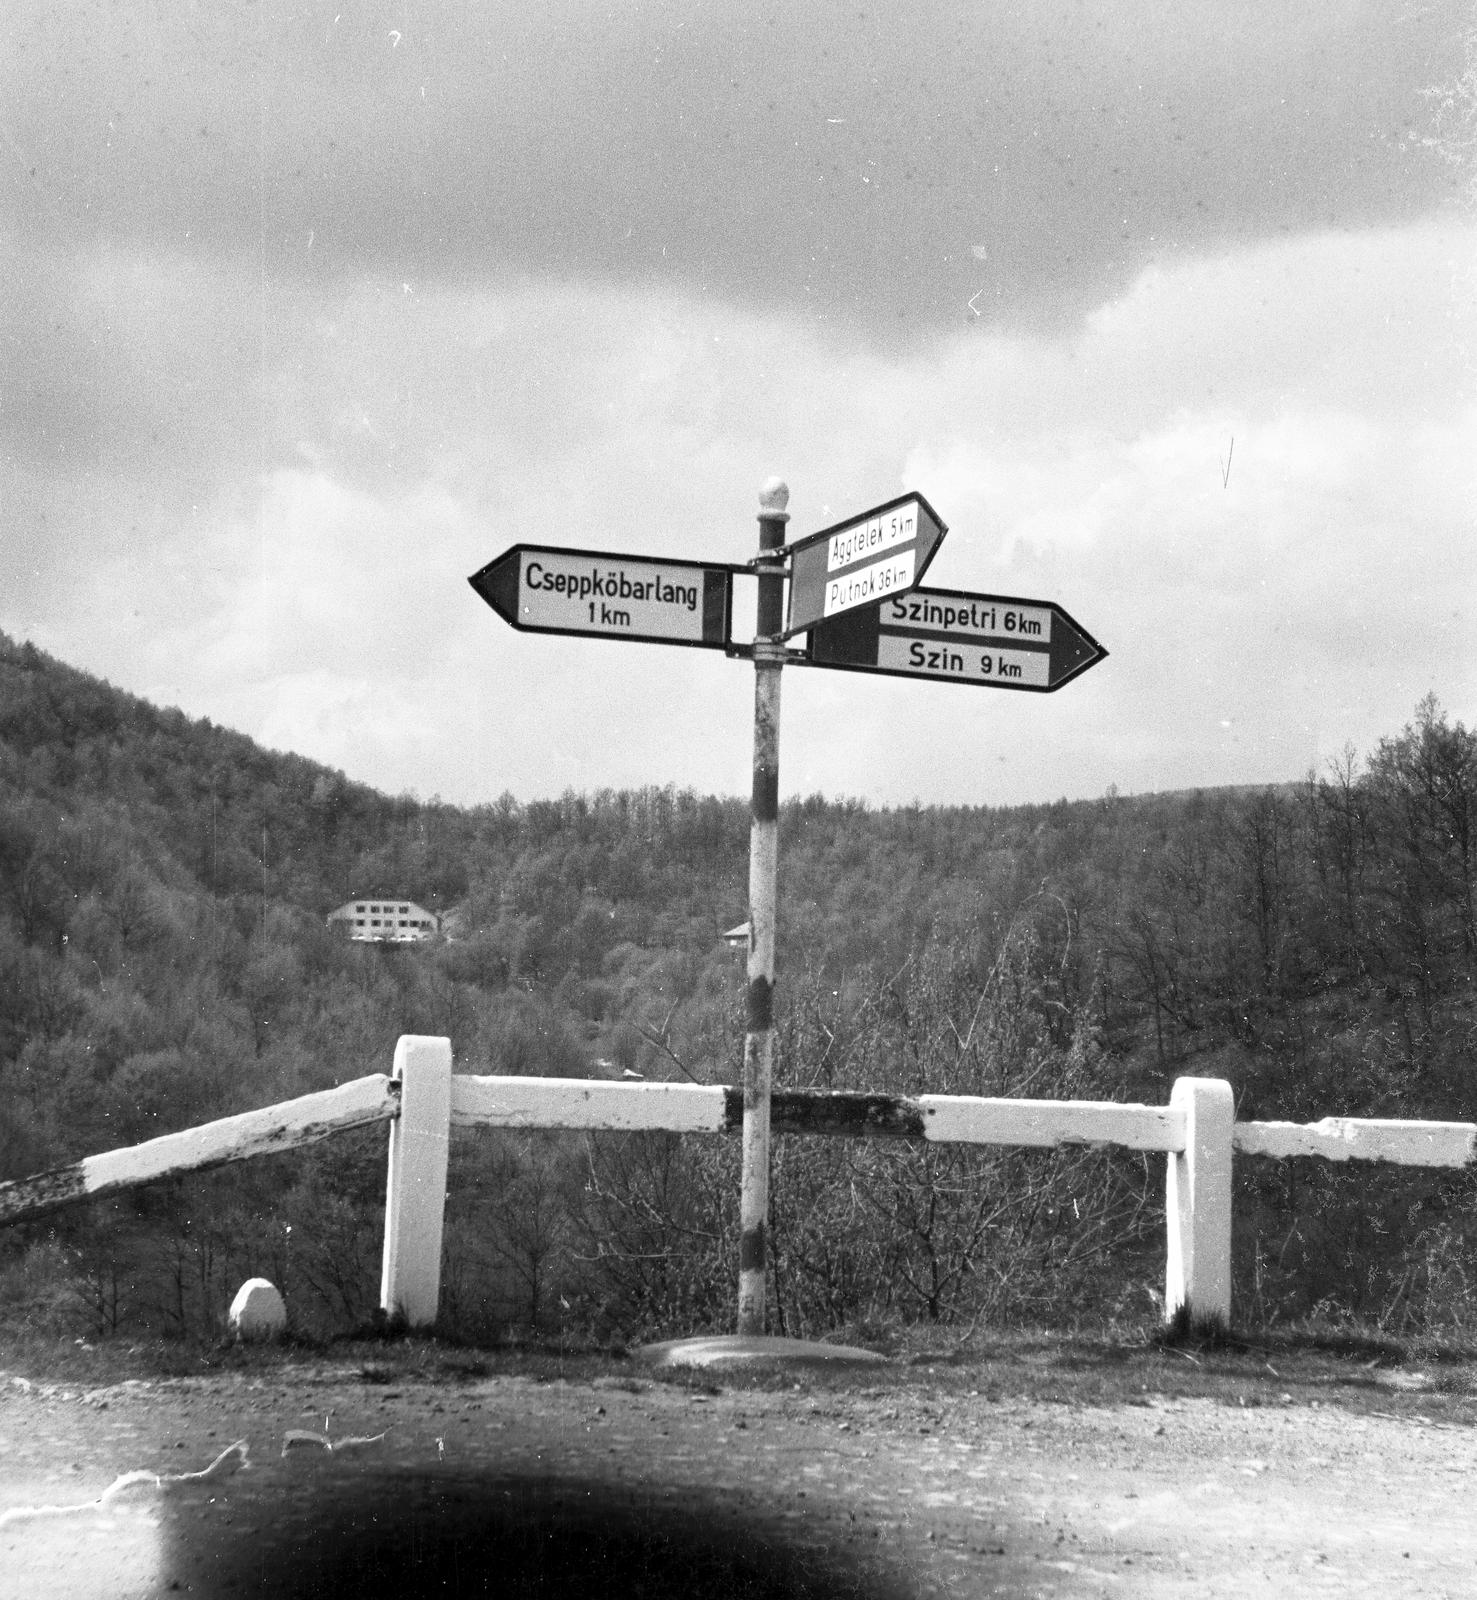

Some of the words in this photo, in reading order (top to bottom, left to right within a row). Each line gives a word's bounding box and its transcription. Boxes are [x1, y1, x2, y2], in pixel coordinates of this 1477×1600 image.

[832, 517, 882, 565] Aggtelek
[891, 518, 897, 538] 5
[526, 562, 697, 611] Cseppköbarlang
[830, 570, 875, 608] Putnok
[588, 602, 595, 622] 1
[601, 603, 630, 626] km
[892, 597, 996, 630] Szinpetri
[909, 642, 963, 671] Szin
[980, 655, 992, 674] 9
[998, 657, 1022, 677] km
